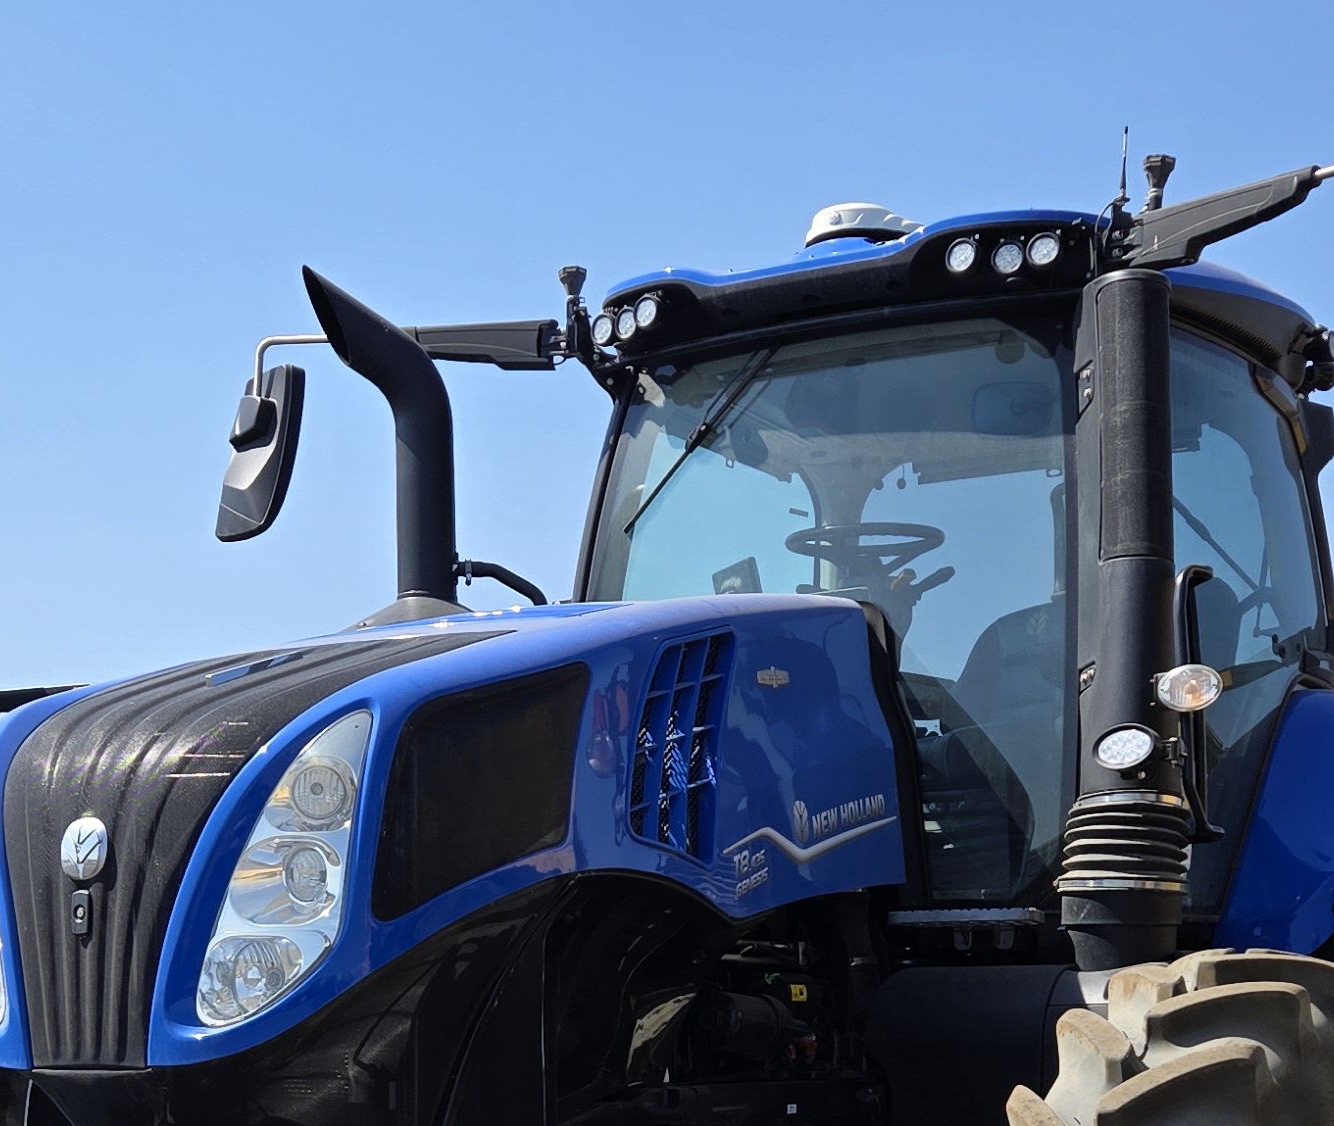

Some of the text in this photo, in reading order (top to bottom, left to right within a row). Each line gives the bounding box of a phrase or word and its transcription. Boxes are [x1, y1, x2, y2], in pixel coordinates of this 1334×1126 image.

[812, 793, 886, 839] NEW HOLLAND
[735, 867, 769, 899] GENESIS
